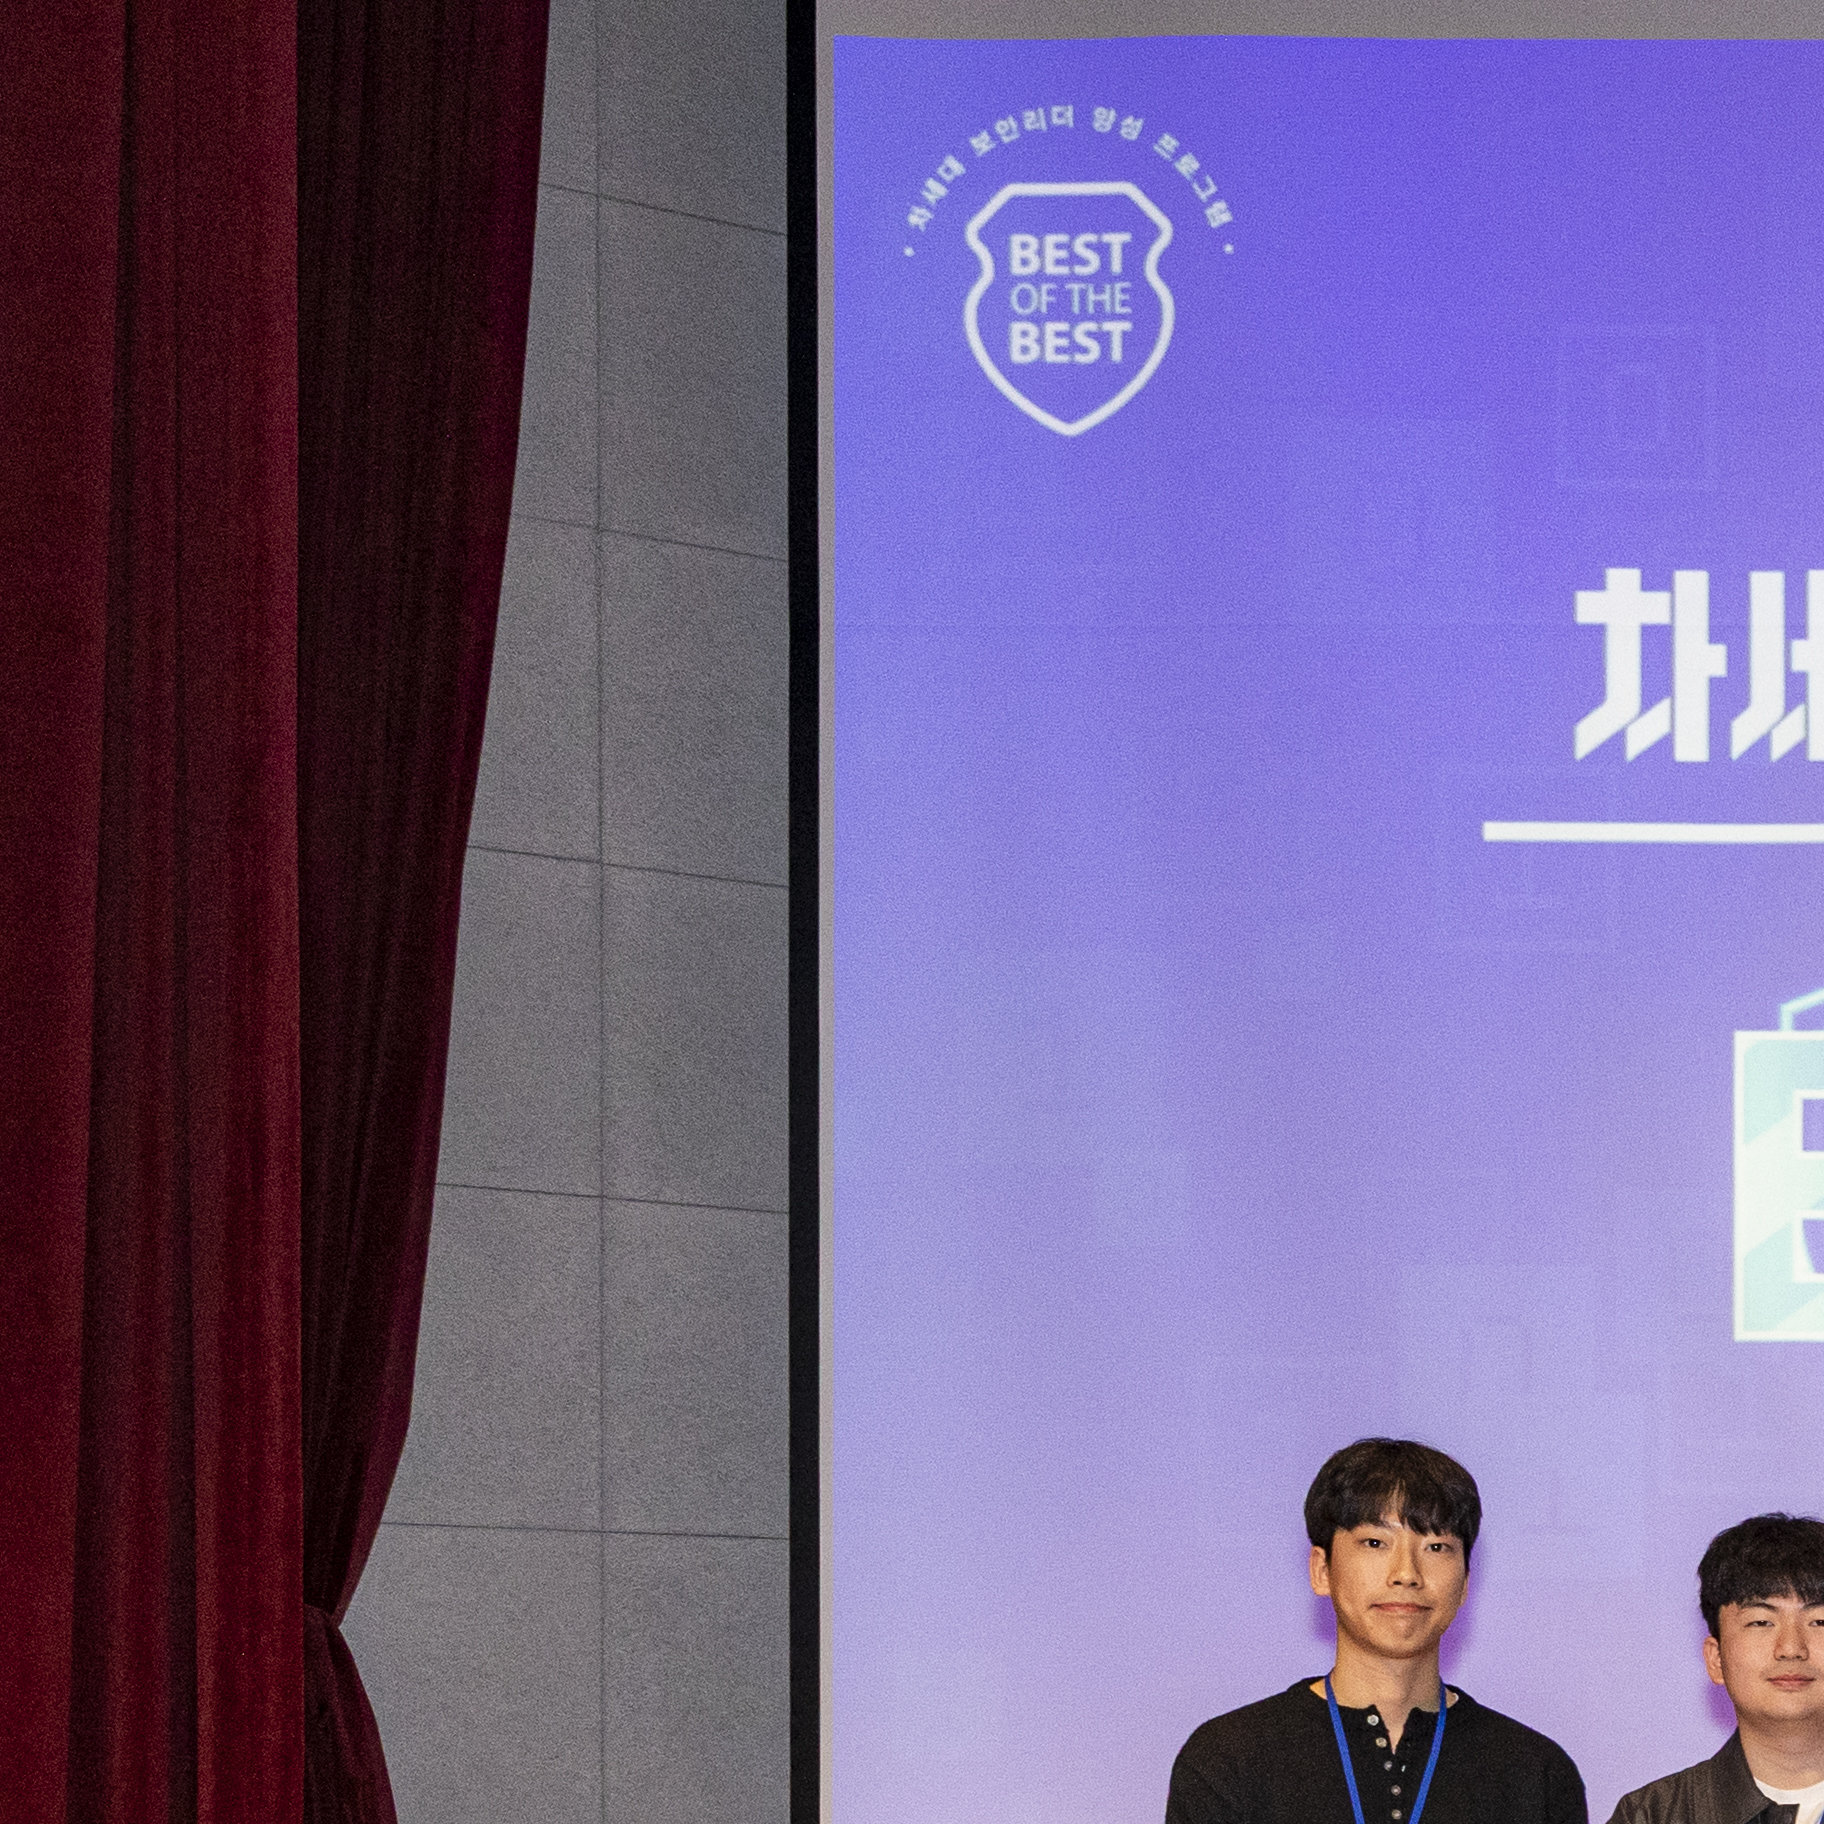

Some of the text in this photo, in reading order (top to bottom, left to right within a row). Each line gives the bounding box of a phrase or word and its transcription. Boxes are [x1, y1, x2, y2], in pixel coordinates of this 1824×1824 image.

[1009, 232, 1133, 276] BEST
[1010, 281, 1133, 316] OF THE
[1009, 320, 1133, 364] BEST
